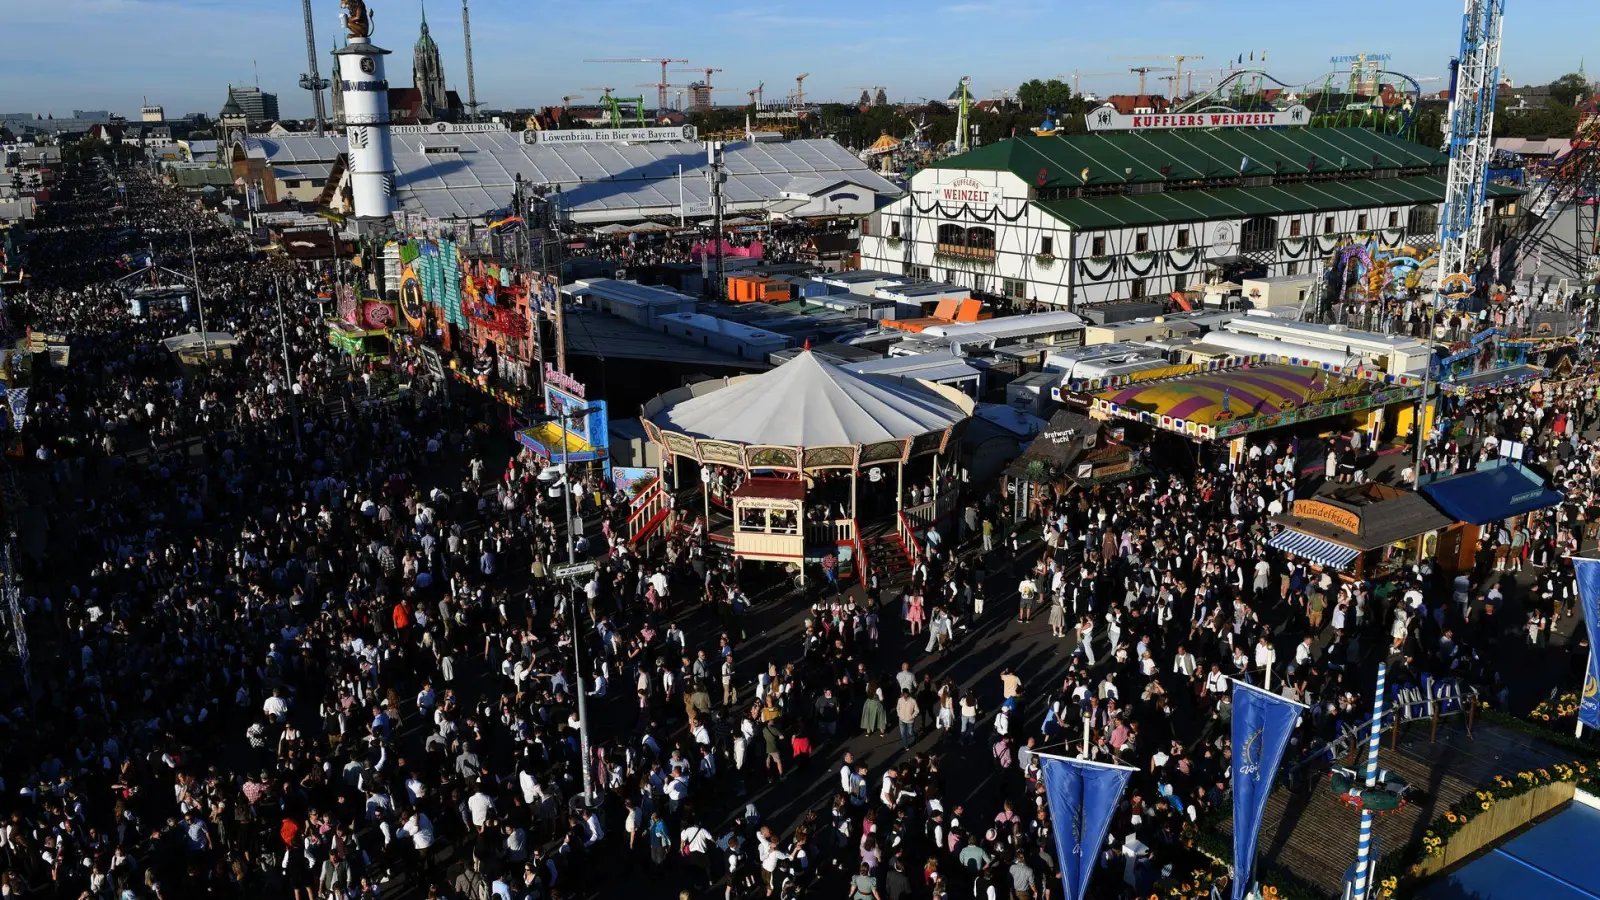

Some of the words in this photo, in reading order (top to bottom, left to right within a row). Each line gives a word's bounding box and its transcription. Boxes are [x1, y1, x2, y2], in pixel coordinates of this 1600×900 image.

[1133, 115, 1203, 127] KUFFLERS
[1211, 114, 1276, 126] WEINZELT
[542, 132, 593, 142] Löwenbräu.
[596, 132, 610, 140] Ein
[613, 131, 630, 140] Bier
[632, 131, 645, 139] wie
[649, 130, 679, 141] Bayern.
[953, 179, 979, 189] KUFFLERS
[944, 189, 989, 202] WEINZELT
[1044, 428, 1075, 439] Bratwurst
[1295, 503, 1357, 529] Mandelküche
